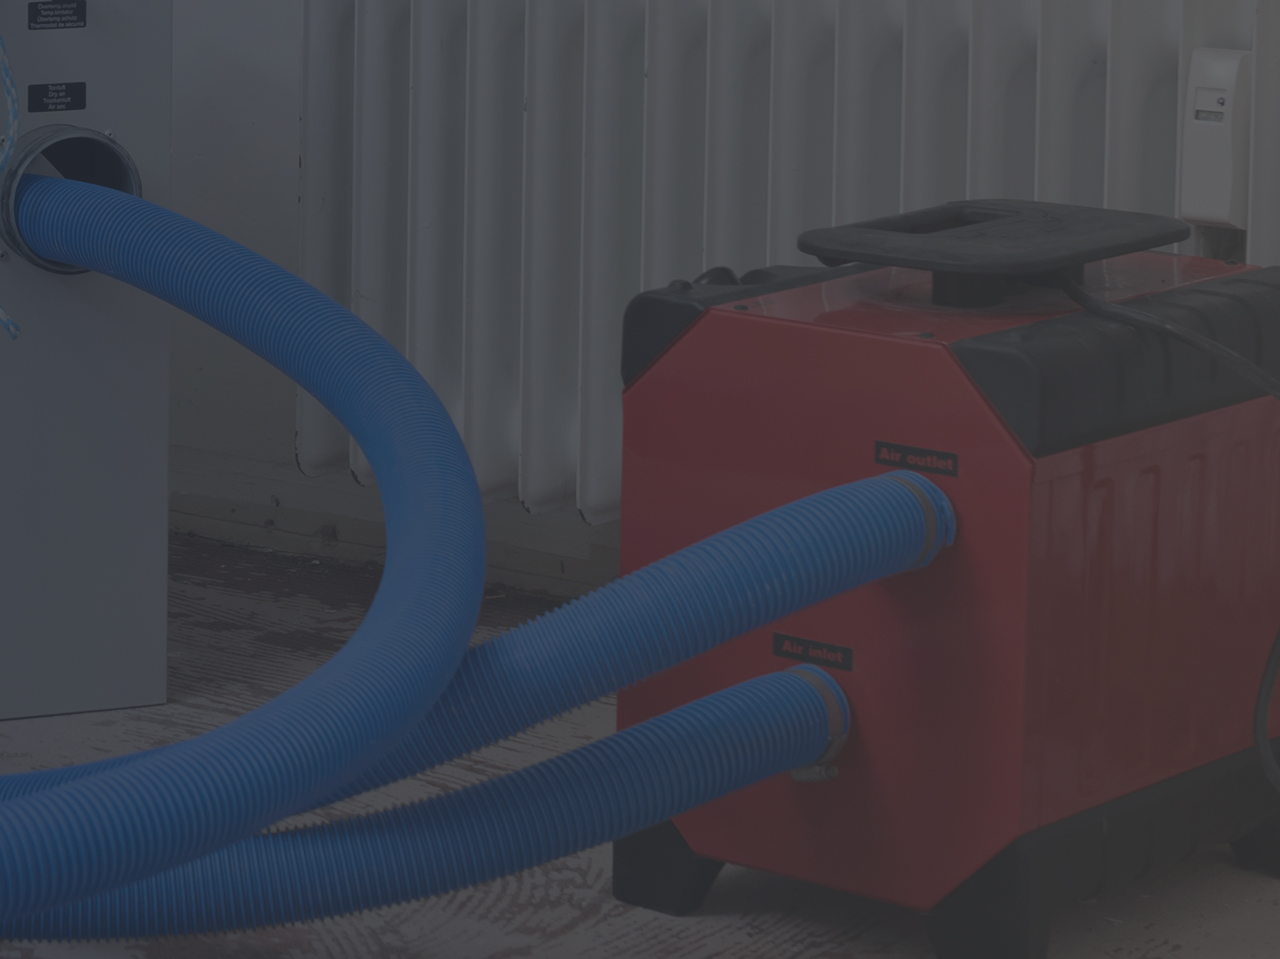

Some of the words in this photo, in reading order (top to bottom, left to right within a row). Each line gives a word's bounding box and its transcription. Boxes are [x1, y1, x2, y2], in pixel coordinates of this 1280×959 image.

[878, 446, 902, 462] Air
[906, 454, 954, 471] outlet
[782, 639, 804, 655] Air
[808, 644, 843, 663] inlet
